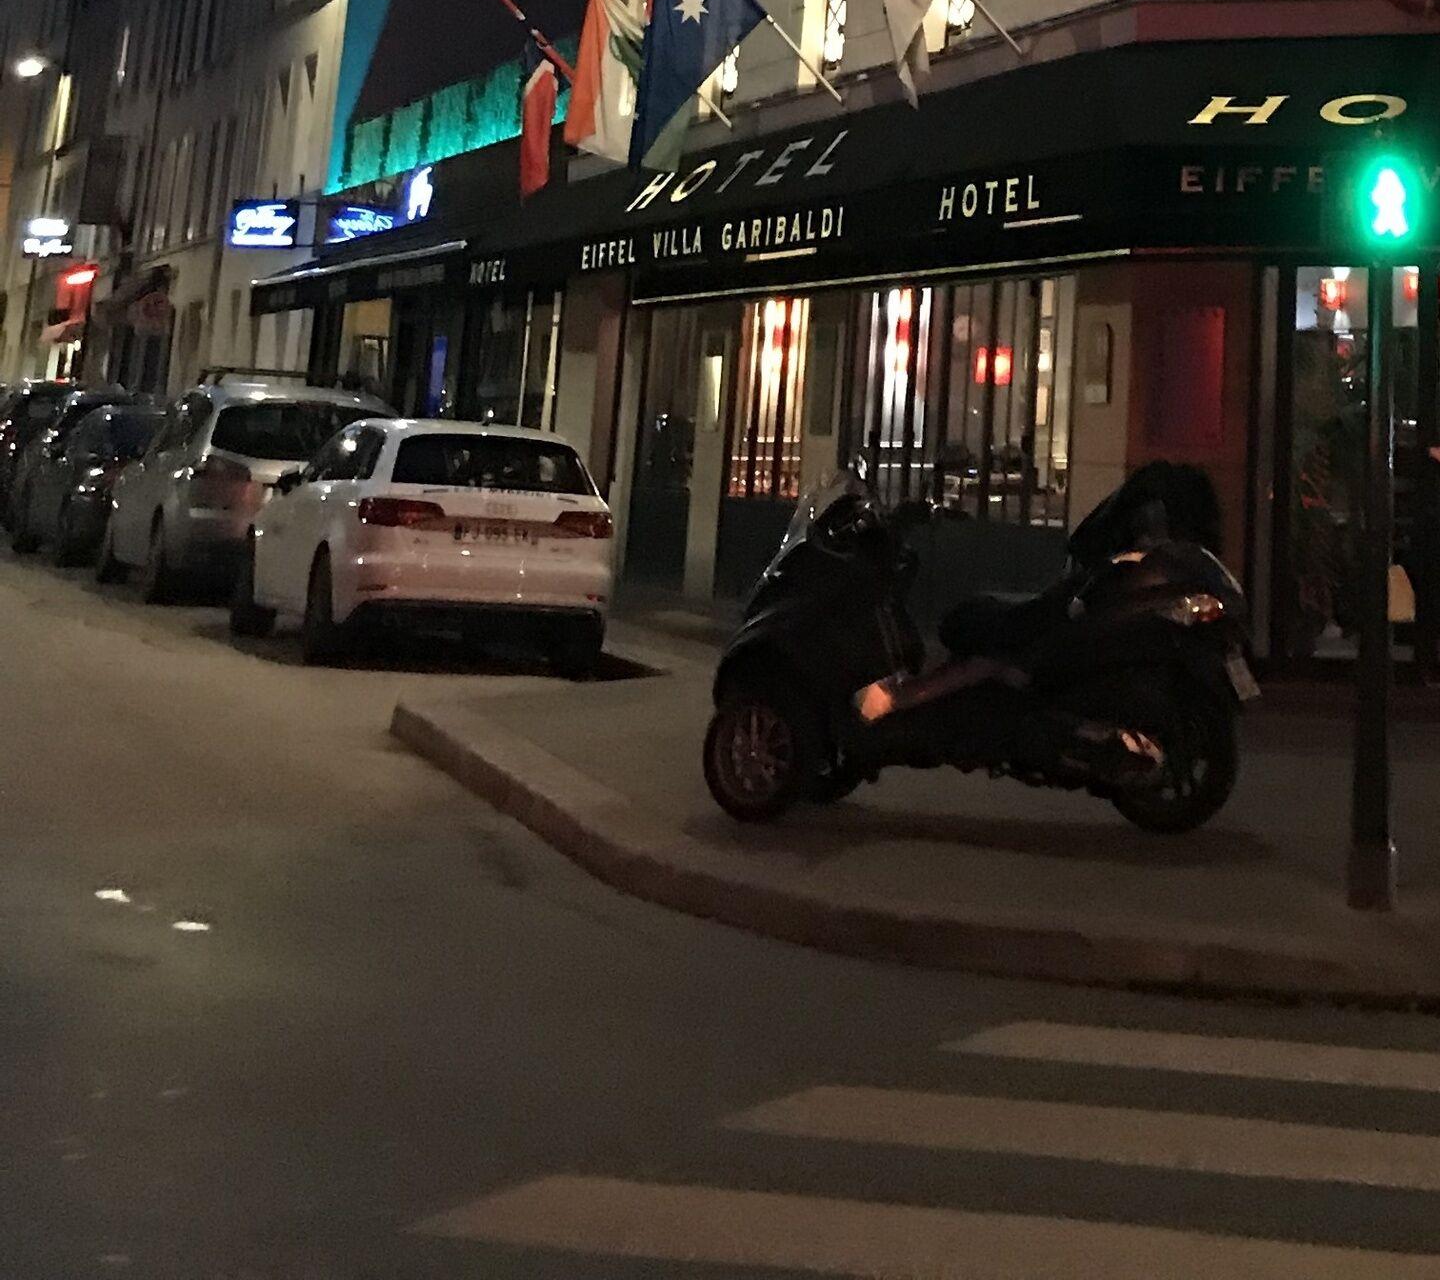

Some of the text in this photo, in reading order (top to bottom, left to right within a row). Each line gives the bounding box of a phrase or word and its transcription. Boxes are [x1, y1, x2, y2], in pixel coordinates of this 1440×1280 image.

[623, 129, 850, 213] HOTEL
[938, 175, 1041, 221] HOTEL
[1180, 164, 1327, 193] EIFFE
[581, 206, 844, 271] EIFFEL VILLA GARIBALDI
